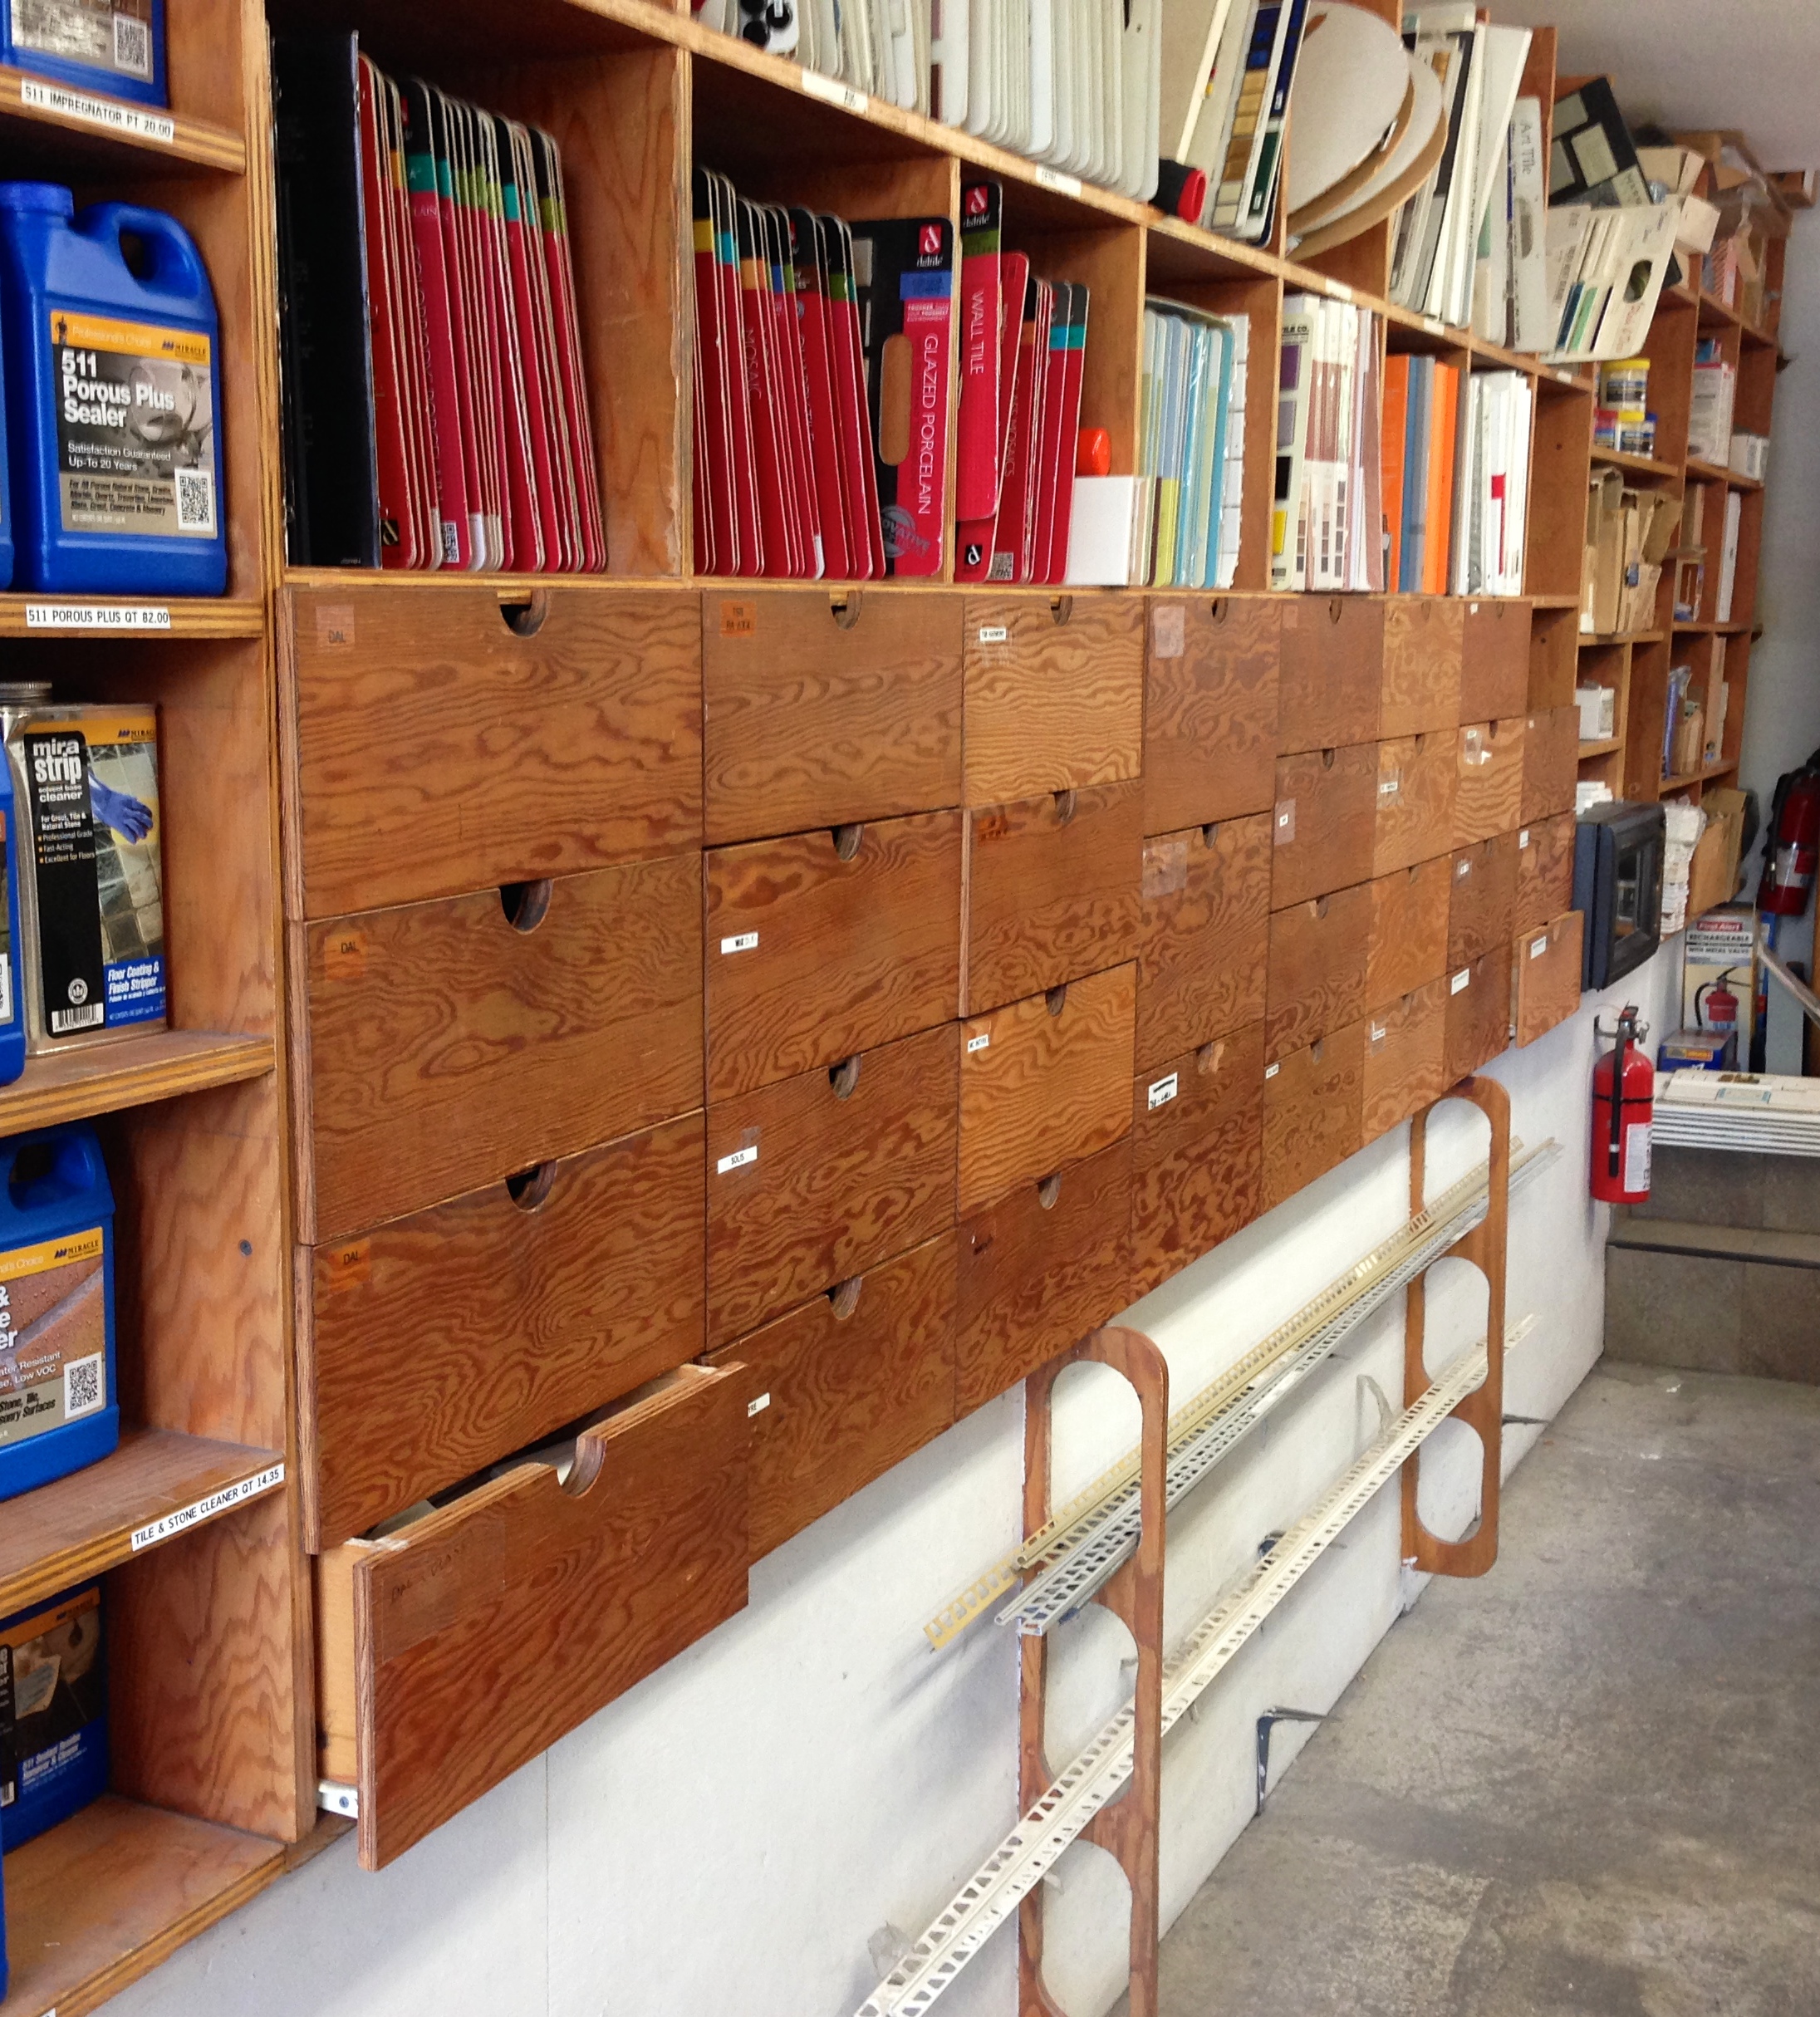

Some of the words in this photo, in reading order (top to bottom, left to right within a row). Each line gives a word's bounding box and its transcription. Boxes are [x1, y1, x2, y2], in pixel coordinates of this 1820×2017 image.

[26, 86, 44, 103] 511
[50, 92, 122, 125] IMPREGNATOR
[126, 115, 139, 129] PT
[144, 120, 171, 138] 20.00
[971, 287, 984, 341] WALL
[61, 347, 97, 378] 511
[970, 340, 984, 375] TILE
[923, 333, 939, 409] GLAZED
[63, 376, 131, 406] Porous
[135, 384, 175, 411] Plus
[64, 396, 127, 428] Sealer
[68, 439, 121, 457] Satisfaction
[123, 447, 171, 462] Guaranteed
[100, 459, 111, 469] 20
[113, 460, 138, 472] Years
[918, 412, 935, 514] PORCELAIN
[28, 609, 47, 622] 511
[52, 610, 93, 623] POROUS
[96, 611, 120, 623] PLUS
[125, 611, 138, 624] QT
[33, 737, 80, 757] mira
[34, 750, 82, 785] strip
[39, 791, 83, 803] cleaner
[341, 941, 359, 955] DAL
[108, 969, 125, 982] Floor
[127, 964, 152, 979] Coating
[154, 960, 159, 973] &
[109, 980, 129, 995] Finish
[131, 975, 157, 990] Stripper
[68, 1239, 99, 1254] MIRACLE
[19, 1351, 61, 1370] Resistant
[15, 1372, 34, 1384] Low
[36, 1364, 56, 1377] VOC
[135, 1526, 154, 1545] TILE
[158, 1523, 164, 1534] &
[168, 1507, 197, 1529] STONE
[200, 1488, 238, 1514] CLEANER
[242, 1480, 253, 1494] QT
[258, 1468, 279, 1488] 14.35
